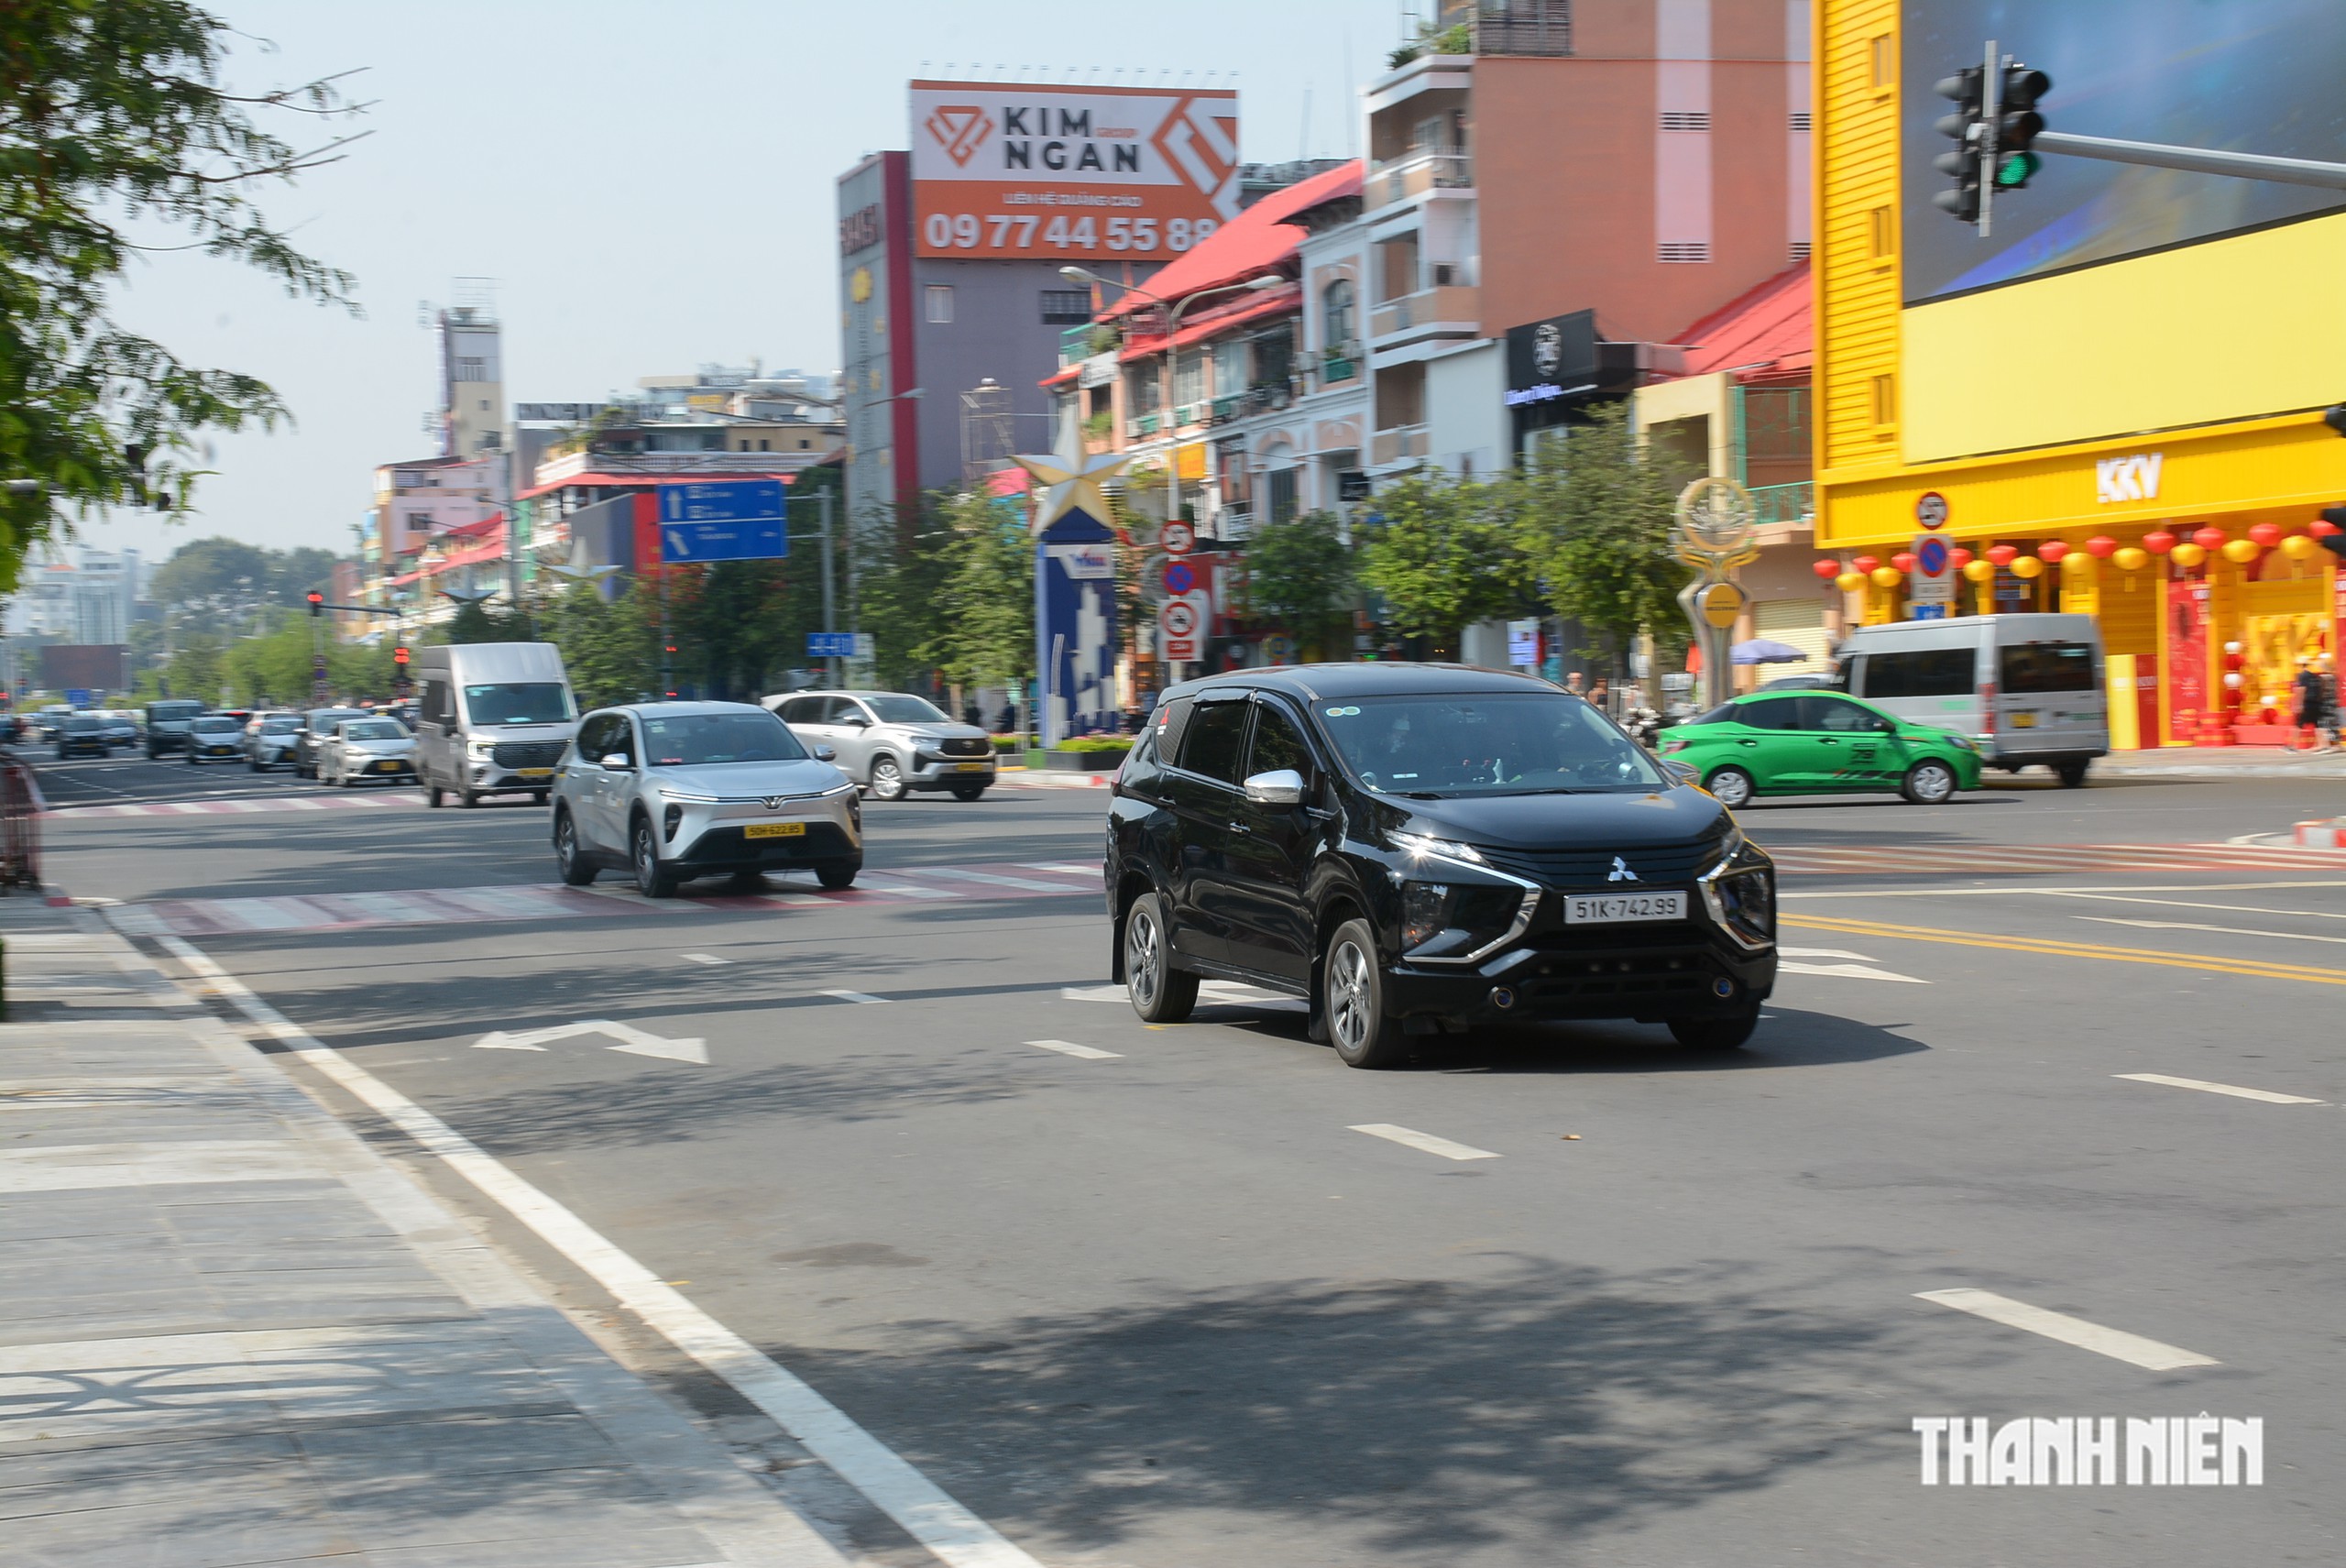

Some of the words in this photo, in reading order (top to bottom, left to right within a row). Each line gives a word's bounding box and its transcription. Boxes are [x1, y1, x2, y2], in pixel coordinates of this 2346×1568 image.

[1003, 106, 1091, 137] KIM
[1004, 141, 1141, 172] NGAN
[925, 214, 981, 248] 09
[986, 215, 1040, 247] 77
[1044, 216, 1098, 249] 44
[1105, 218, 1158, 251] 55
[2096, 452, 2163, 503] KKV
[1576, 898, 1677, 918] 51K-742.99
